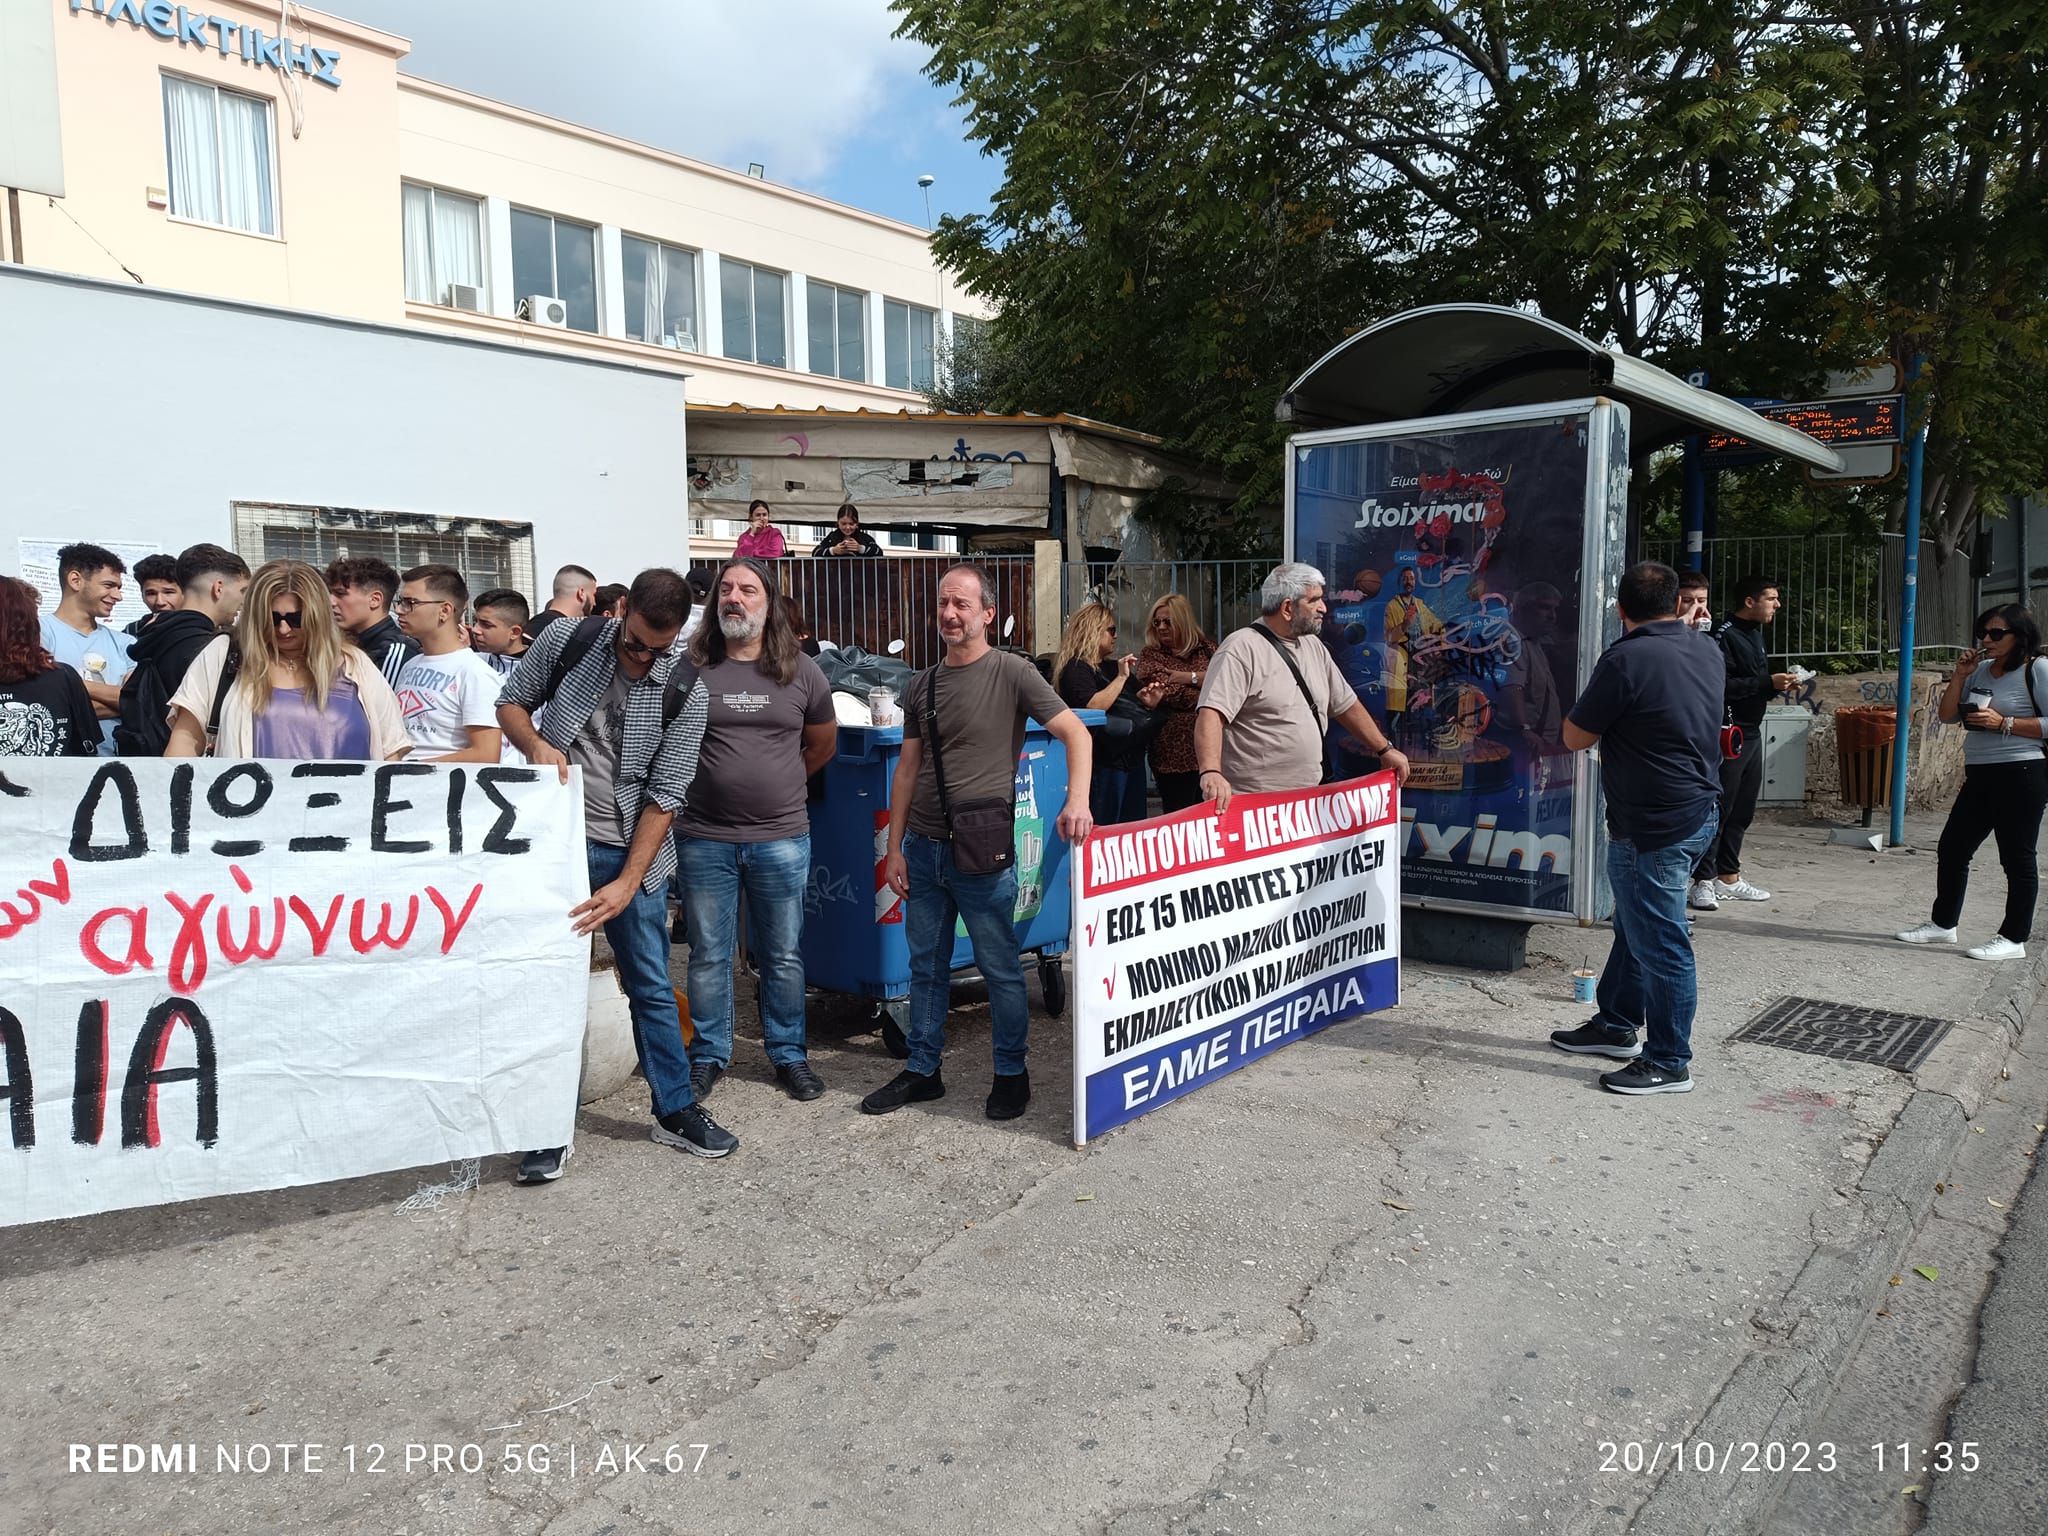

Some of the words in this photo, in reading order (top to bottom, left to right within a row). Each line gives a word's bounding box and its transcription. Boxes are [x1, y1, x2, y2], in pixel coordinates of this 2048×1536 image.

[69, 761, 541, 862] ΔΙΩΞΕΙΣ
[1090, 816, 1225, 888] ΑΠΑΙΤΟΥΜΕ
[1242, 783, 1391, 852] ΔΙΕΚΔΙΚΟΥΜΕ
[1107, 901, 1145, 945] ΕΩΣ
[1149, 893, 1177, 931] 15
[1180, 868, 1291, 923] ΜΑΘΗΤΕΣ
[1290, 853, 1341, 895] ΣΤΗΝ
[1341, 840, 1385, 876] ΤΑΞΗ
[1126, 940, 1222, 1000] ΜΟΝΙΜΟΙ
[1224, 914, 1289, 969] ΜΑΖΙΚΟΙ
[1293, 890, 1367, 941] ΔΙΟΡΙΣΜΟΙ
[1103, 972, 1251, 1058] ΕΚΠΑΙΔΕΥΤΙΚΩΝ
[1255, 957, 1284, 999] ΚΑΙ
[1282, 922, 1385, 986] ΚΑΘΑΡΙΣΤΡΙΩΝ
[1123, 1030, 1232, 1111] ΕΛΜΕ
[1240, 976, 1364, 1055] ΠΕΙΡΑΙΑ
